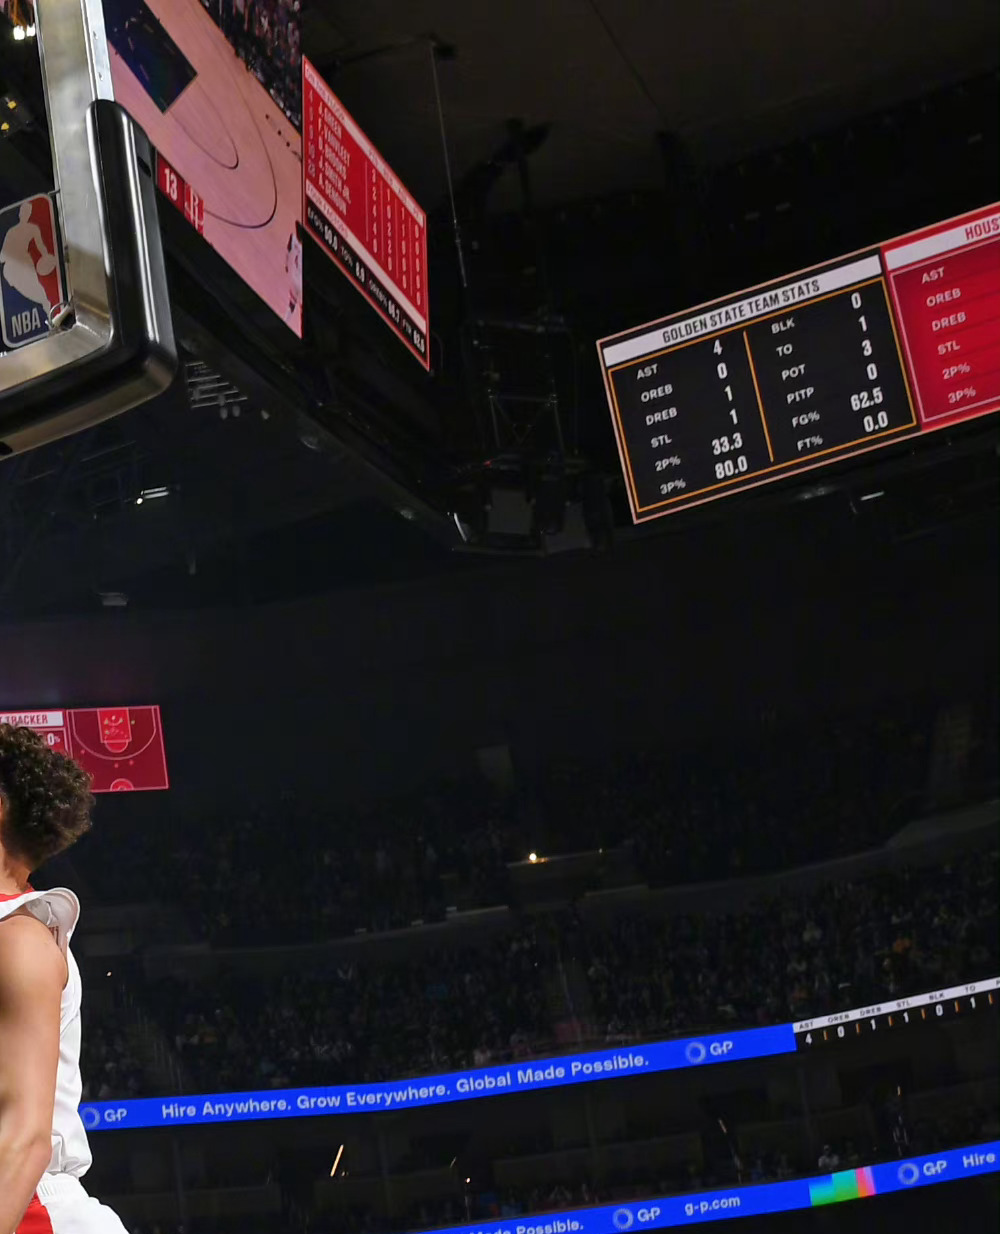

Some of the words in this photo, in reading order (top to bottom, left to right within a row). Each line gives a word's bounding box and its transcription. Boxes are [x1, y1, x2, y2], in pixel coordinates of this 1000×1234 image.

[164, 168, 177, 201] 13
[922, 266, 945, 284] AST
[662, 319, 707, 343] GOLDEN
[710, 305, 745, 327] STATE
[749, 293, 780, 313] TEAM
[783, 280, 820, 302] STATS
[771, 318, 795, 334] BLK
[851, 292, 862, 309] 0
[926, 288, 961, 307] OREB
[11, 307, 41, 338] NBA
[776, 344, 792, 357] TO
[859, 315, 867, 332] 1
[932, 312, 966, 331] DREB
[637, 363, 658, 379] AST
[713, 339, 722, 355] 4
[782, 364, 805, 381] POT
[862, 339, 872, 356] 3
[938, 340, 960, 355] STL
[641, 384, 673, 402] OREB
[717, 362, 727, 379] 0
[787, 387, 814, 404] PITP
[867, 363, 878, 380] 0
[943, 362, 970, 379] 2P%
[645, 407, 677, 426] DREB
[724, 385, 733, 401] 1
[792, 410, 820, 428] FG%
[851, 387, 883, 411] 62.5
[948, 386, 976, 403] 3P%
[651, 434, 672, 448] STL
[730, 408, 738, 424] 1
[797, 435, 823, 451] FT%
[864, 411, 888, 432] 0.0
[655, 455, 681, 471] 2P%
[712, 432, 742, 455] 33.3
[660, 478, 686, 494] 3P%
[715, 455, 748, 479] 80.0
[5, 714, 48, 726] TRACKER
[799, 1021, 814, 1030] AST
[827, 1014, 850, 1024] OREB
[860, 1007, 882, 1017] DREB
[896, 1000, 911, 1008] STL
[929, 992, 945, 1001] BLK
[965, 985, 976, 993] TO
[805, 1033, 813, 1045] 4
[837, 1025, 845, 1038] 0
[870, 1019, 876, 1031] 1
[903, 1012, 909, 1023] 1
[935, 1004, 943, 1017] 0
[970, 996, 976, 1009] 1
[162, 1103, 197, 1119] Hire
[202, 1098, 291, 1117] Anywhere.
[297, 1095, 341, 1109] Grow
[346, 1085, 451, 1107] Everywhere.
[456, 1072, 512, 1093] Global
[517, 1066, 565, 1085] Made
[571, 1053, 649, 1077] Possible.
[962, 1151, 996, 1169] Hire
[684, 1195, 741, 1217] g-p.com
